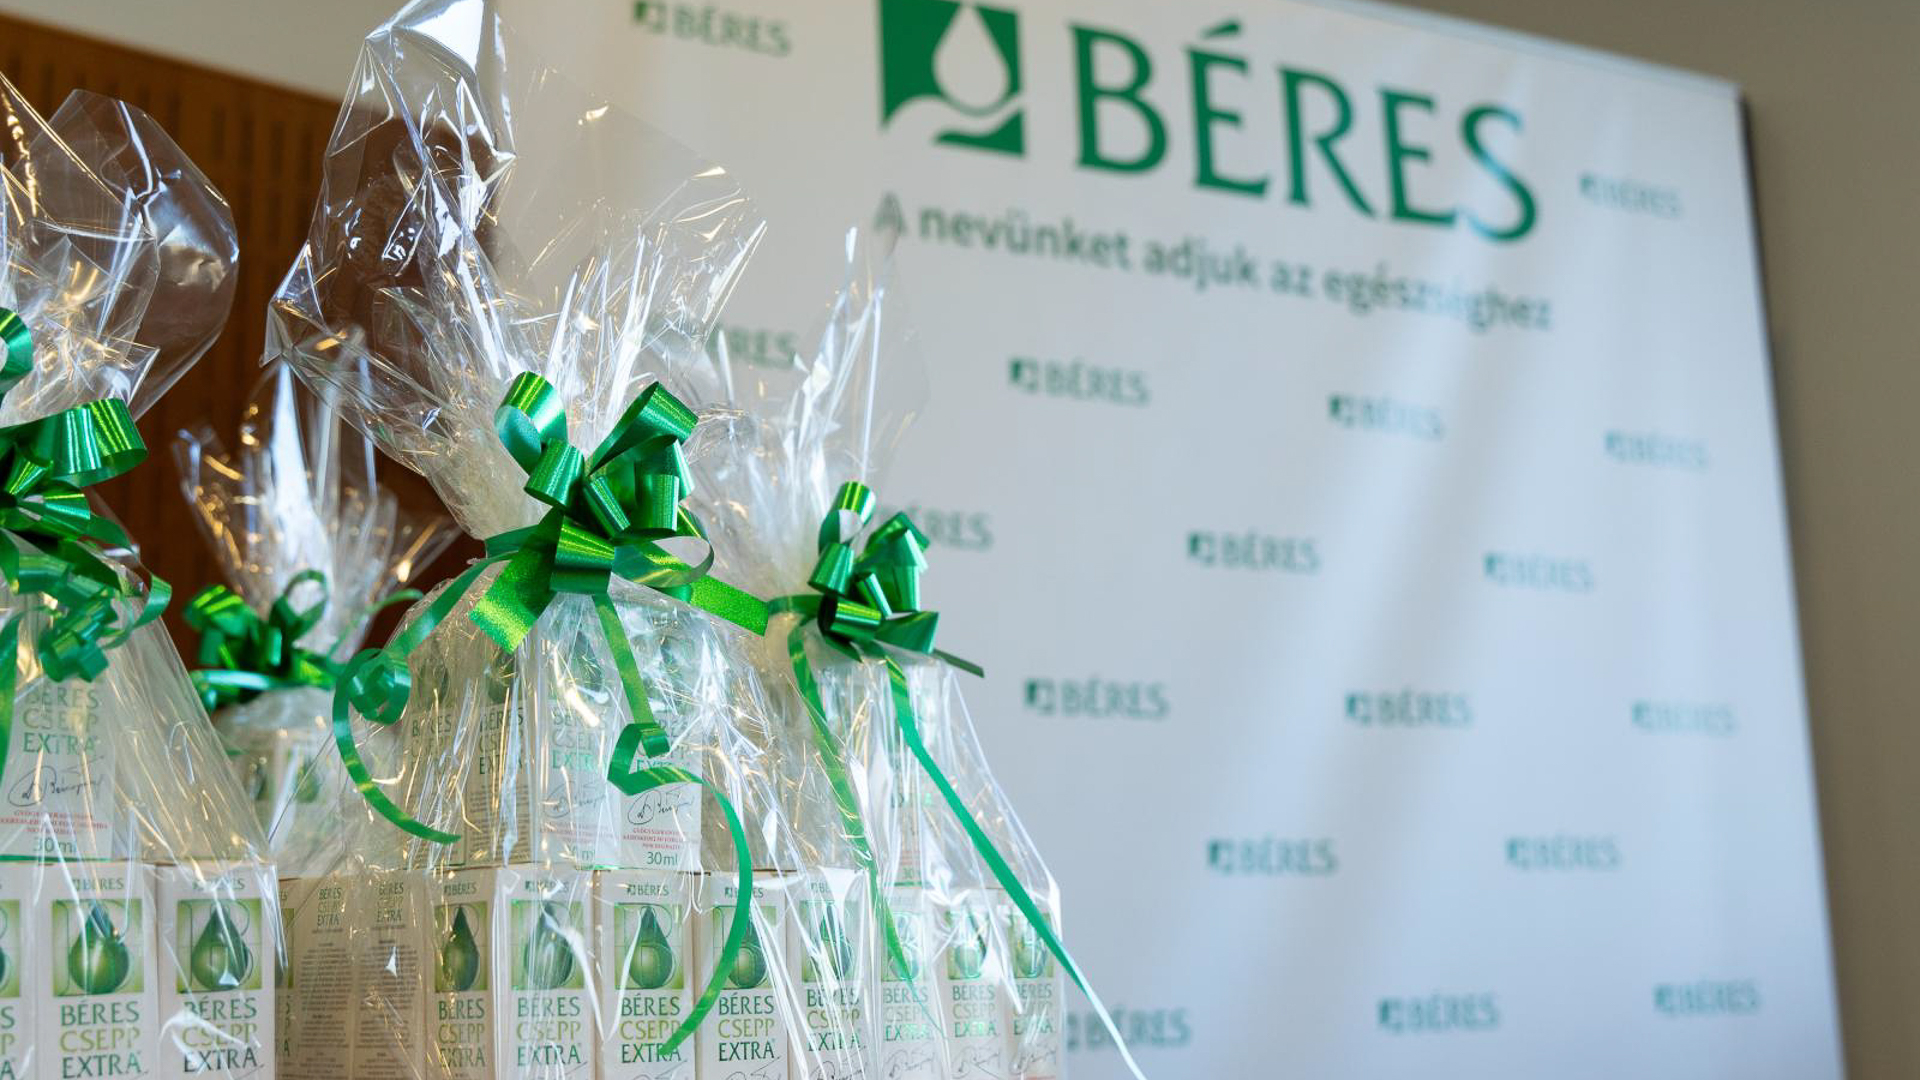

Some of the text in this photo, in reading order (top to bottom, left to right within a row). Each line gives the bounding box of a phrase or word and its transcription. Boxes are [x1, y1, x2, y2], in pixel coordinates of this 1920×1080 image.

[1069, 19, 1538, 243] BÉRES
[874, 192, 907, 234] A
[918, 207, 1132, 272] nevünket
[1143, 235, 1257, 293] adjuk
[1270, 260, 1313, 297] az
[1045, 356, 1151, 407] BÉRES
[1219, 528, 1321, 575] BÉRES
[1060, 671, 1170, 721] BÉRES
[647, 851, 678, 866] 30ml
[61, 999, 140, 1026] BÉRES
[621, 993, 681, 1017] BÉRES
[719, 992, 775, 1016] BÉRES
[60, 1026, 140, 1052] CSEPP
[438, 1023, 485, 1044] CSEPP
[718, 1018, 775, 1039] CSEPP
[184, 1046, 258, 1073] EXTRA
[719, 1039, 776, 1062] EXTRA
[62, 1052, 142, 1079] EXTRA
